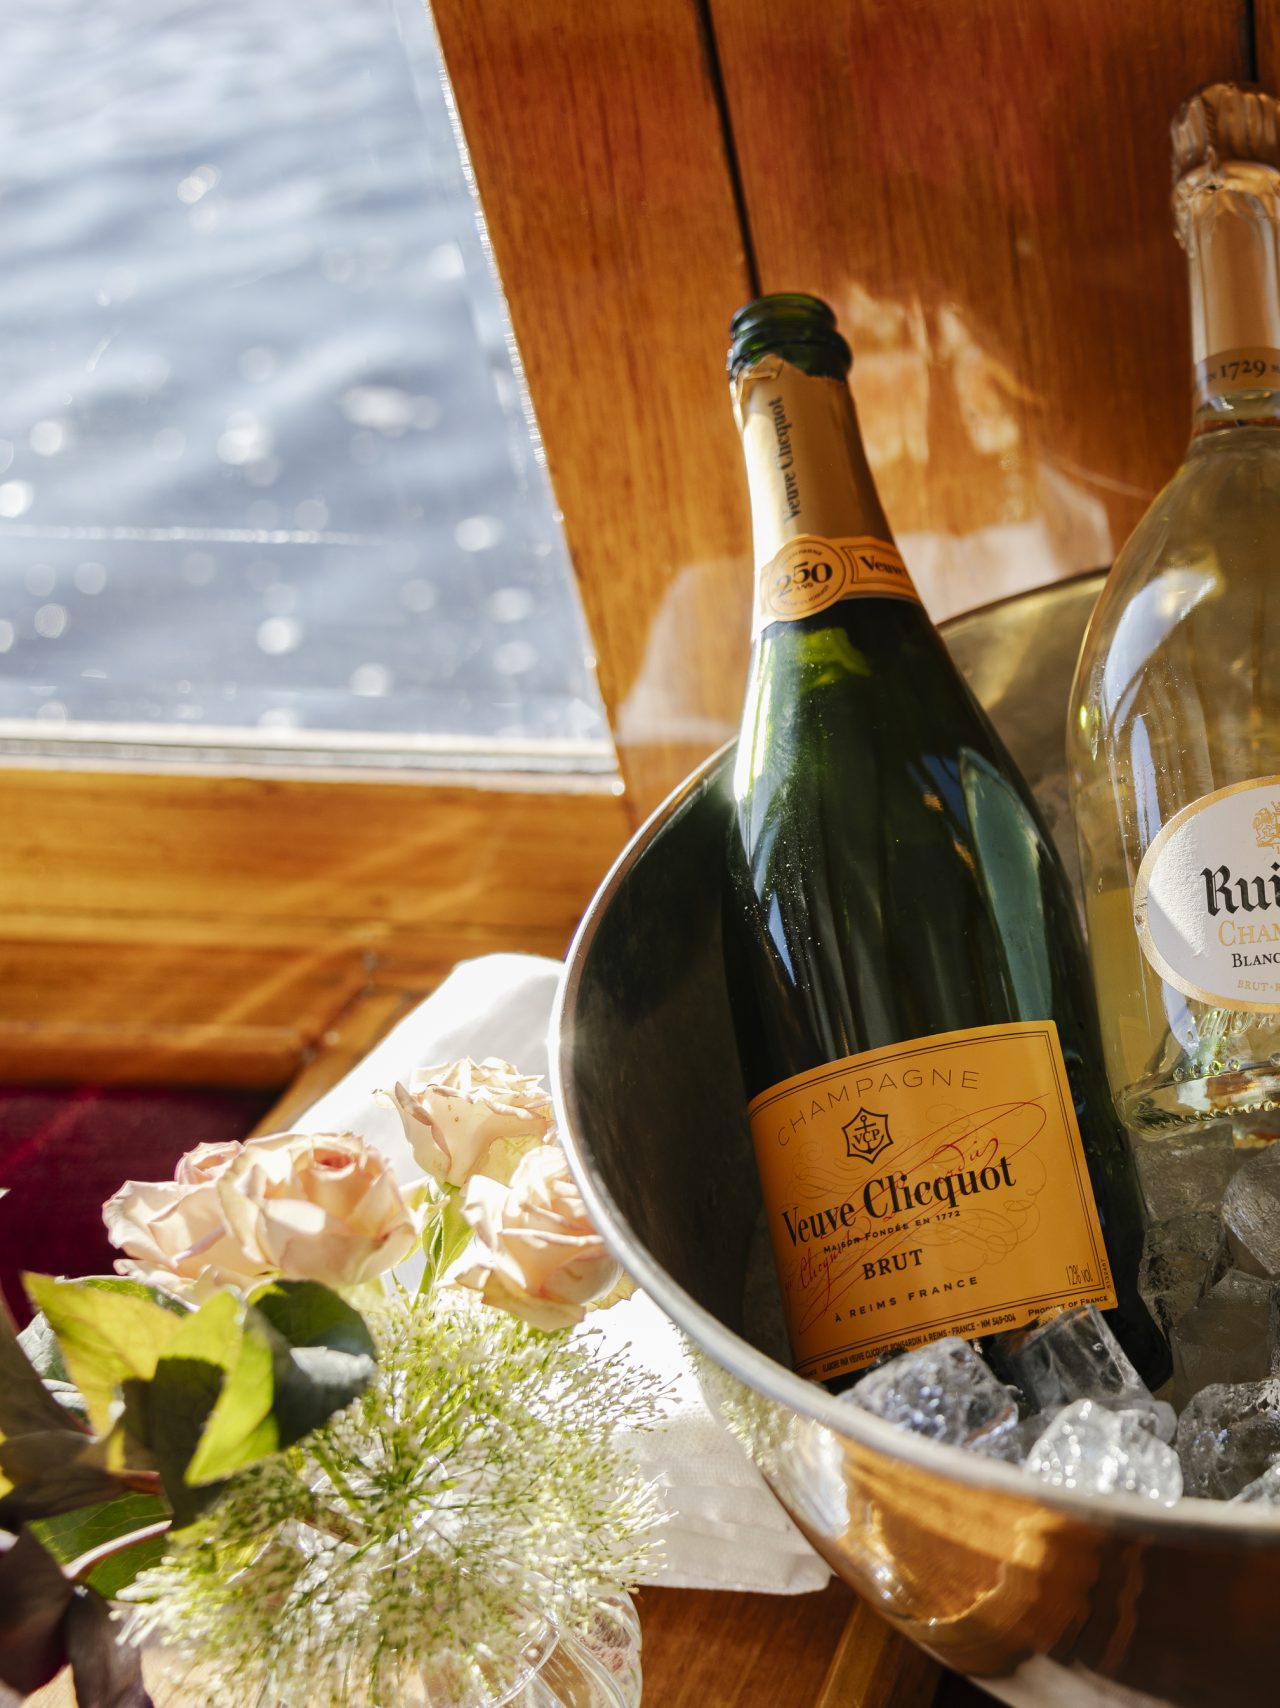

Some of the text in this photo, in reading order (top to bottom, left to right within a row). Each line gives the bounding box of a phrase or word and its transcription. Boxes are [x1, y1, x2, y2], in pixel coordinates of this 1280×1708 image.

[1219, 359, 1267, 381] 1729
[768, 396, 793, 470] Clicquot
[783, 472, 801, 524] Veuve
[775, 561, 833, 597] 250
[1237, 979, 1268, 992] BRUT
[777, 1067, 981, 1147] CHAMPAGNE
[853, 1129, 880, 1144] VCP
[781, 1202, 857, 1248] Veuve
[863, 1156, 1017, 1219] Clicquot
[914, 1216, 930, 1227] EN
[936, 1210, 960, 1222] 1772
[862, 1248, 923, 1281] BRUT
[850, 1297, 897, 1317] REIMS
[908, 1276, 978, 1301] FRANCE
[1080, 1296, 1108, 1307] FRANCE
[952, 1323, 976, 1336] FRANCE
[981, 1318, 991, 1328] NM
